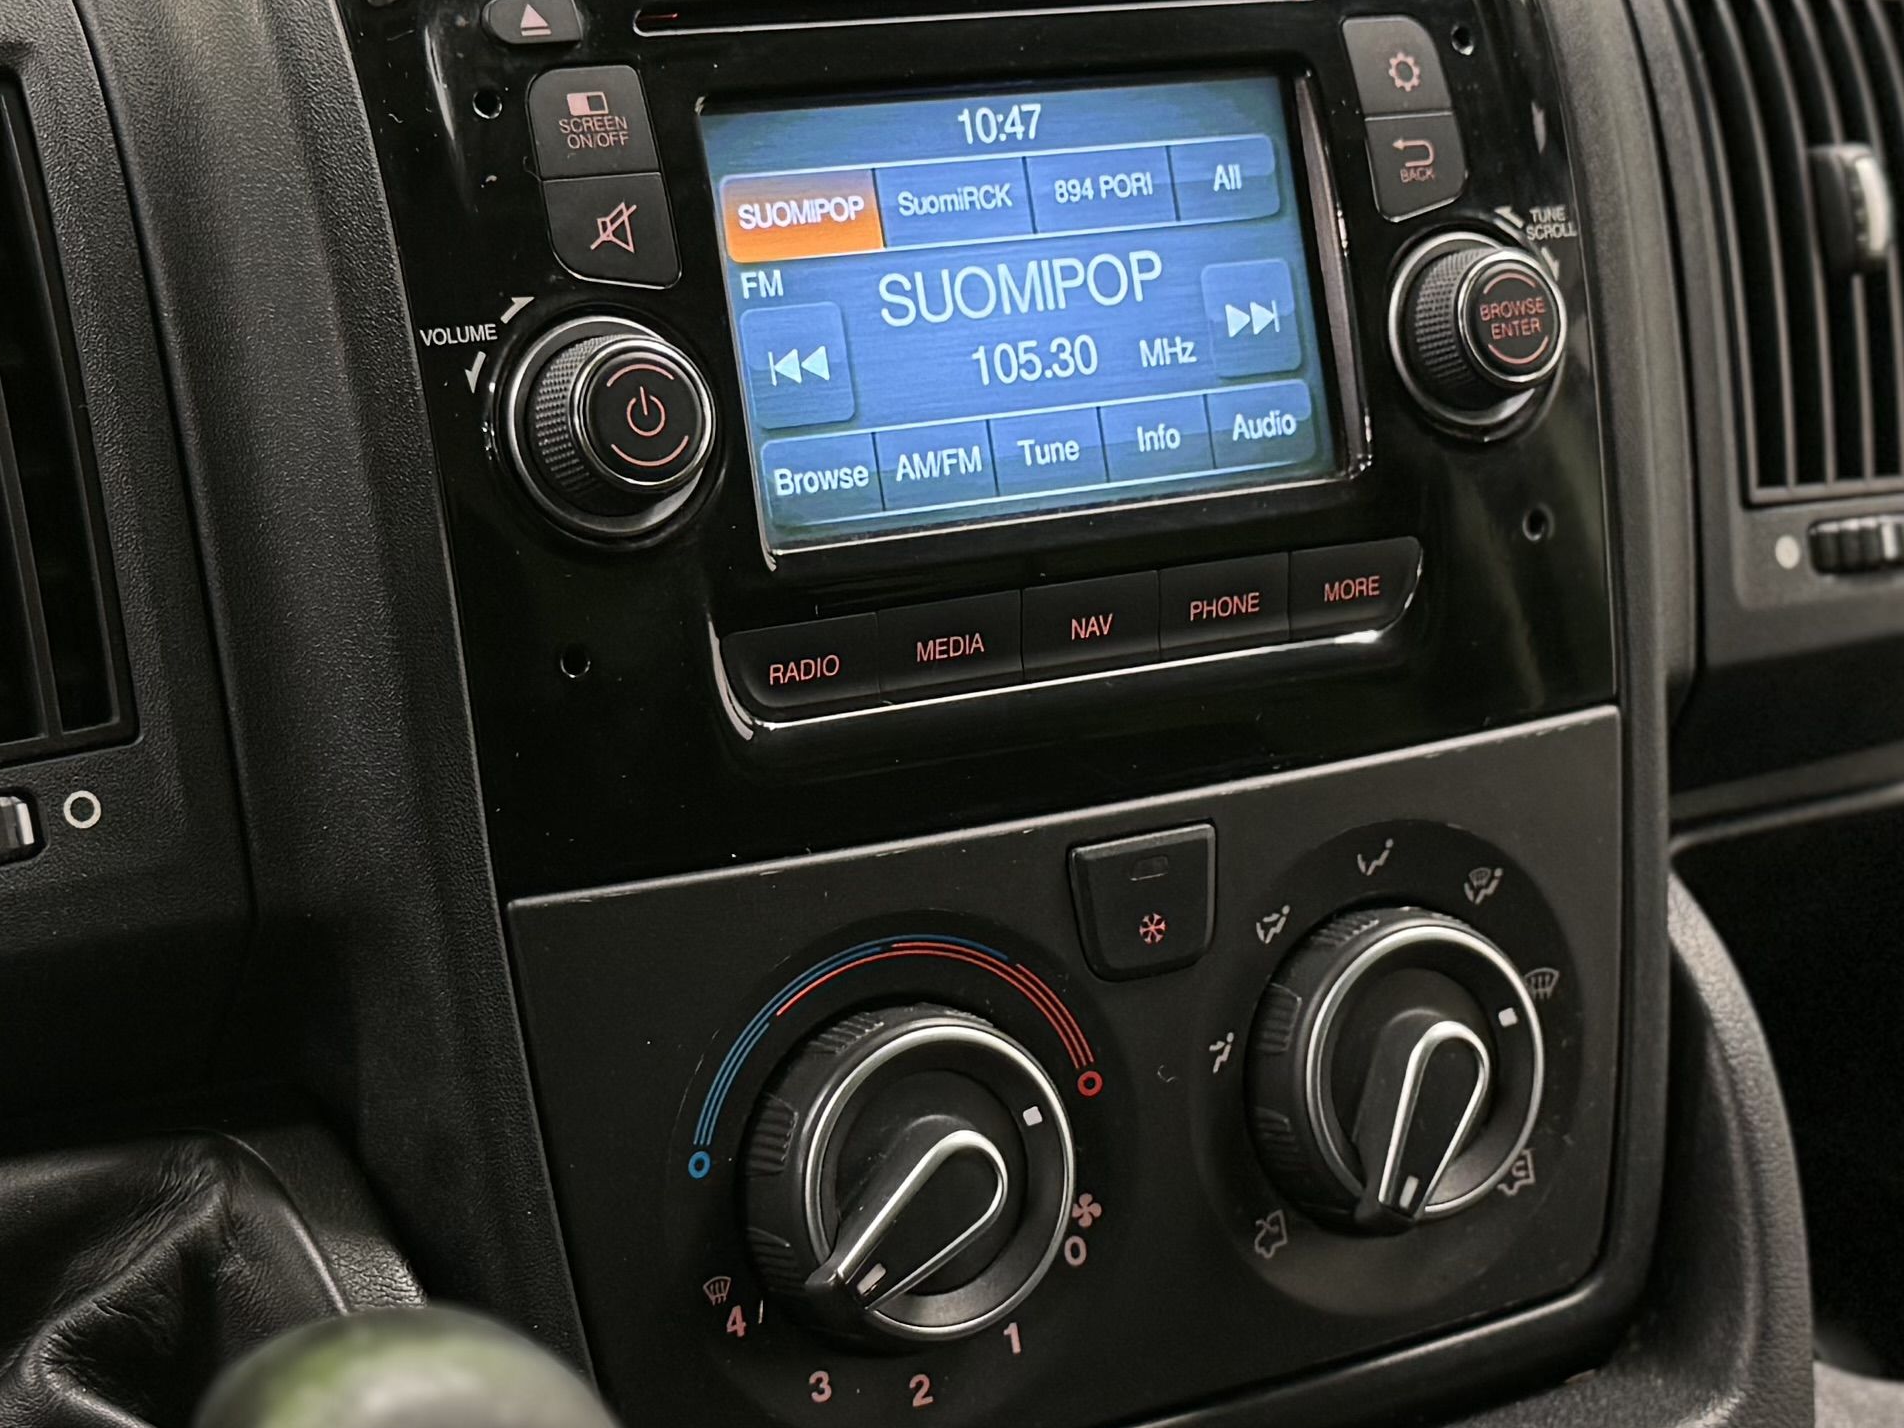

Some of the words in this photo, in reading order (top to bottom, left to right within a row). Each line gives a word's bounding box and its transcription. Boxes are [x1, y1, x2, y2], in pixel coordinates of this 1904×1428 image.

[559, 116, 628, 134] SCREEN
[567, 131, 629, 149] ON/OFF
[957, 104, 1042, 145] 10:47
[1054, 178, 1094, 204] 894
[1099, 172, 1153, 200] PORI
[1213, 165, 1242, 193] All
[1399, 167, 1435, 183] BACK
[738, 196, 865, 230] SUOMIPOP
[897, 182, 1013, 216] SuomiRCK
[1529, 204, 1566, 223] TUNE
[1526, 221, 1577, 241] SCROLL
[741, 270, 783, 299] FM
[879, 249, 1163, 328] SUOMIPOP
[1479, 297, 1546, 321] BROWSE
[420, 323, 498, 347] VOLUME
[1491, 318, 1542, 340] ENTER
[972, 335, 1098, 386] 105.30
[1139, 337, 1198, 369] MHz
[1137, 424, 1181, 453] Info
[1231, 410, 1296, 442] Audio
[896, 447, 982, 484] AM/FM
[1018, 437, 1080, 468] Tune
[774, 462, 870, 499] Browse
[1323, 575, 1381, 603] MORE
[1189, 592, 1261, 621] PHONE
[1070, 613, 1113, 641] NAV
[916, 632, 985, 663] MEDIA
[769, 654, 840, 686] RADIO
[1063, 1234, 1087, 1267] 0
[726, 1304, 747, 1338] 4
[1002, 1321, 1022, 1355] 1
[808, 1370, 832, 1403] 3
[908, 1373, 934, 1408] 2
